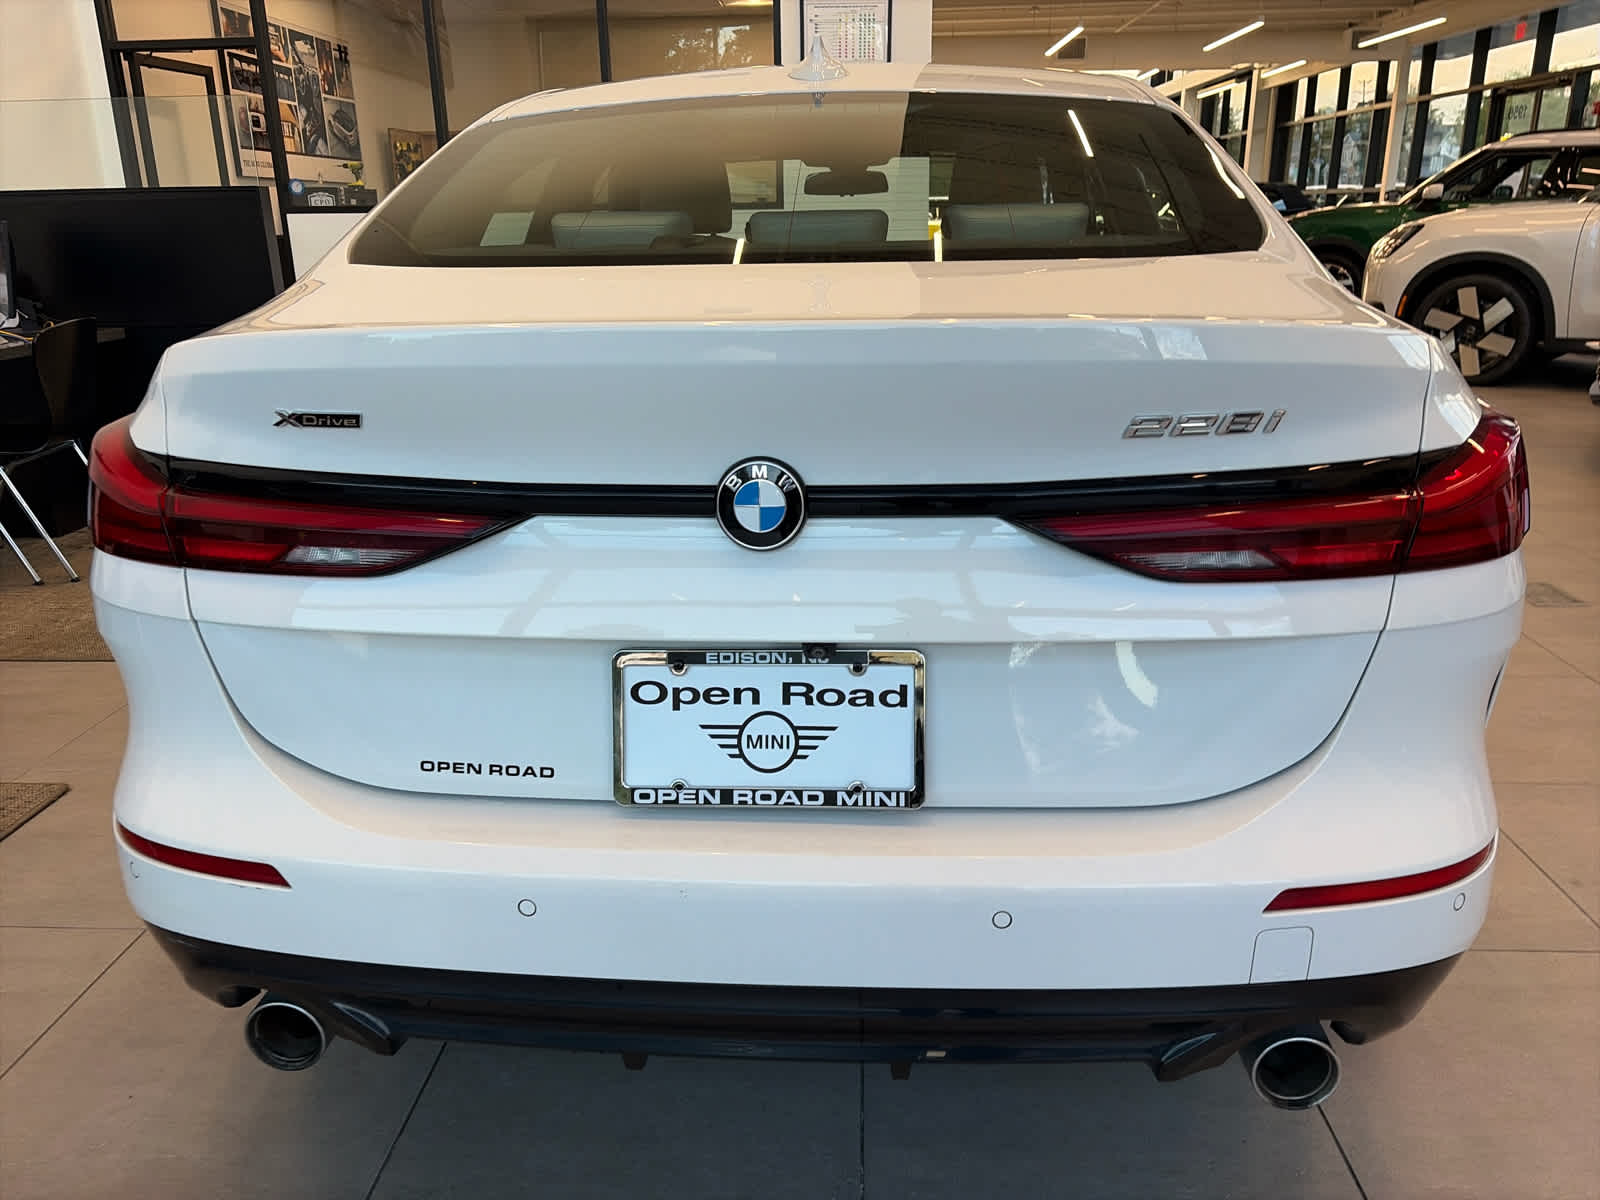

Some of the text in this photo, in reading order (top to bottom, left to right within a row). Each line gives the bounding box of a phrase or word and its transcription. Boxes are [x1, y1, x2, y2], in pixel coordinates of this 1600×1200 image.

[1122, 409, 1287, 439] 228i
[725, 464, 796, 493] BMW
[705, 652, 793, 664] EDISON,
[630, 680, 908, 711] Open Road
[746, 734, 791, 750] MINI
[420, 760, 555, 778] OPEN ROAD
[633, 788, 906, 807] OPEN ROAD MINI
